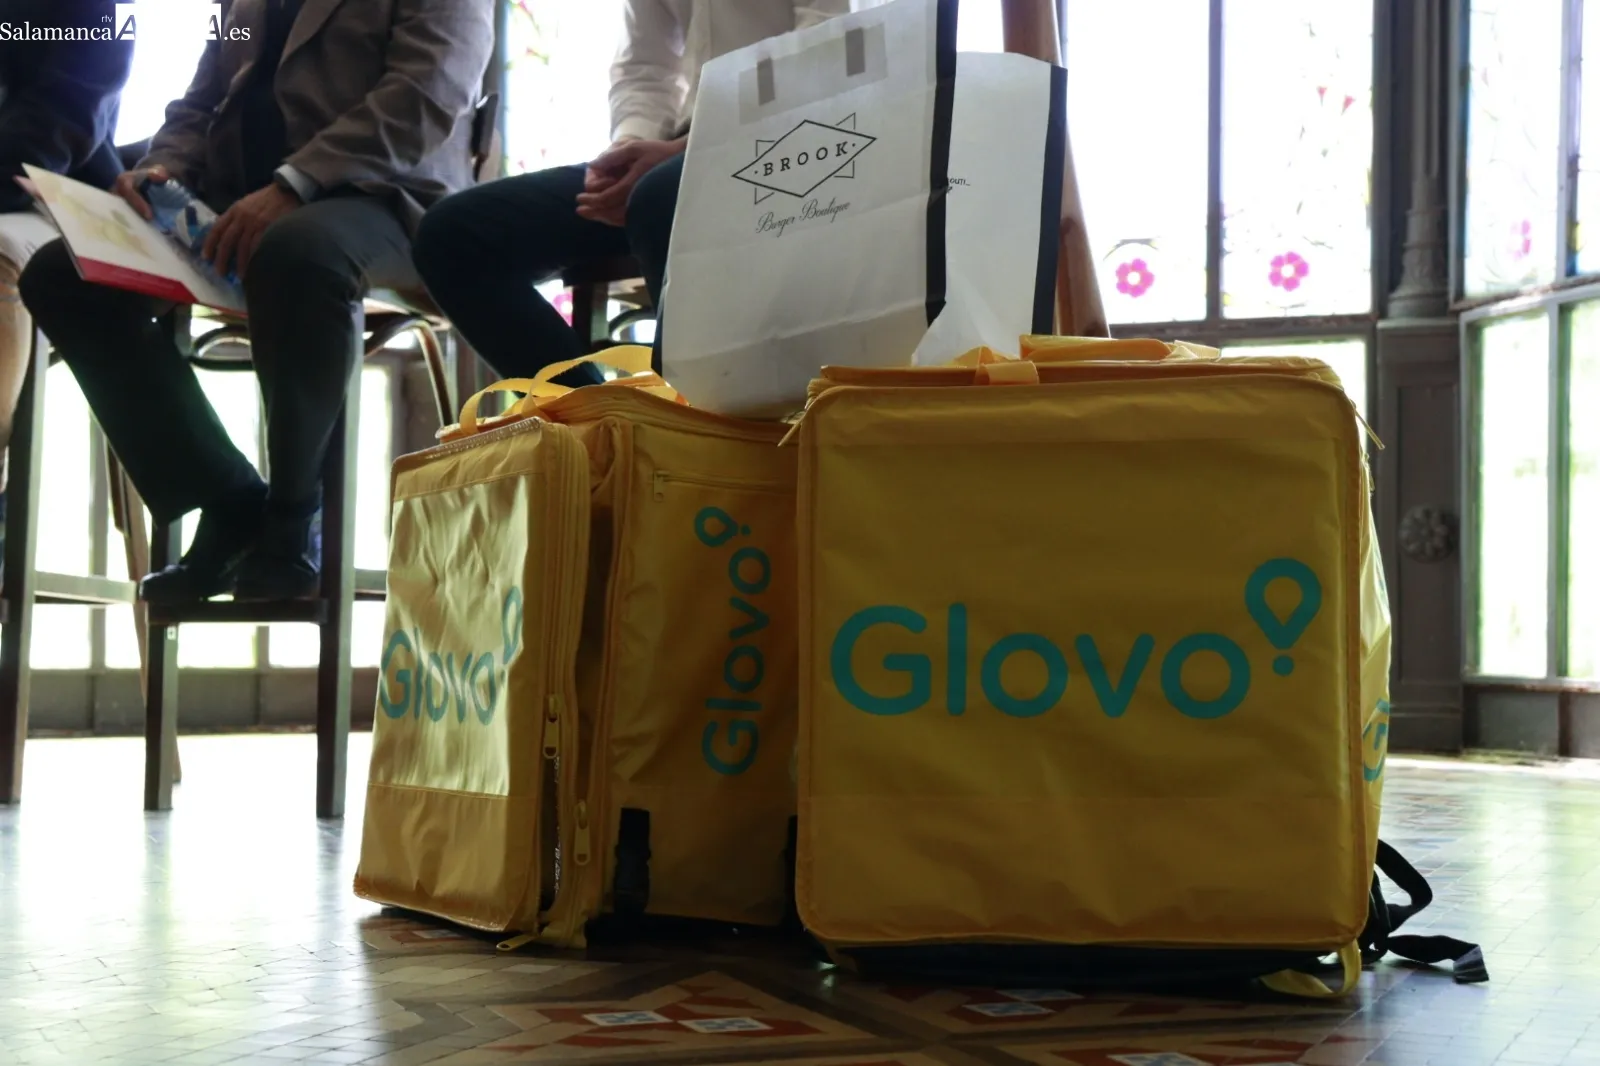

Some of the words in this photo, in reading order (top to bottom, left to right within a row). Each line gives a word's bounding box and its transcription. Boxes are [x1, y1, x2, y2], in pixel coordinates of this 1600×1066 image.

[755, 211, 796, 238] Burger
[799, 196, 851, 223] Boutique
[380, 624, 497, 726] Glovo
[700, 546, 772, 776] Glovo
[830, 602, 1252, 719] Glovo
